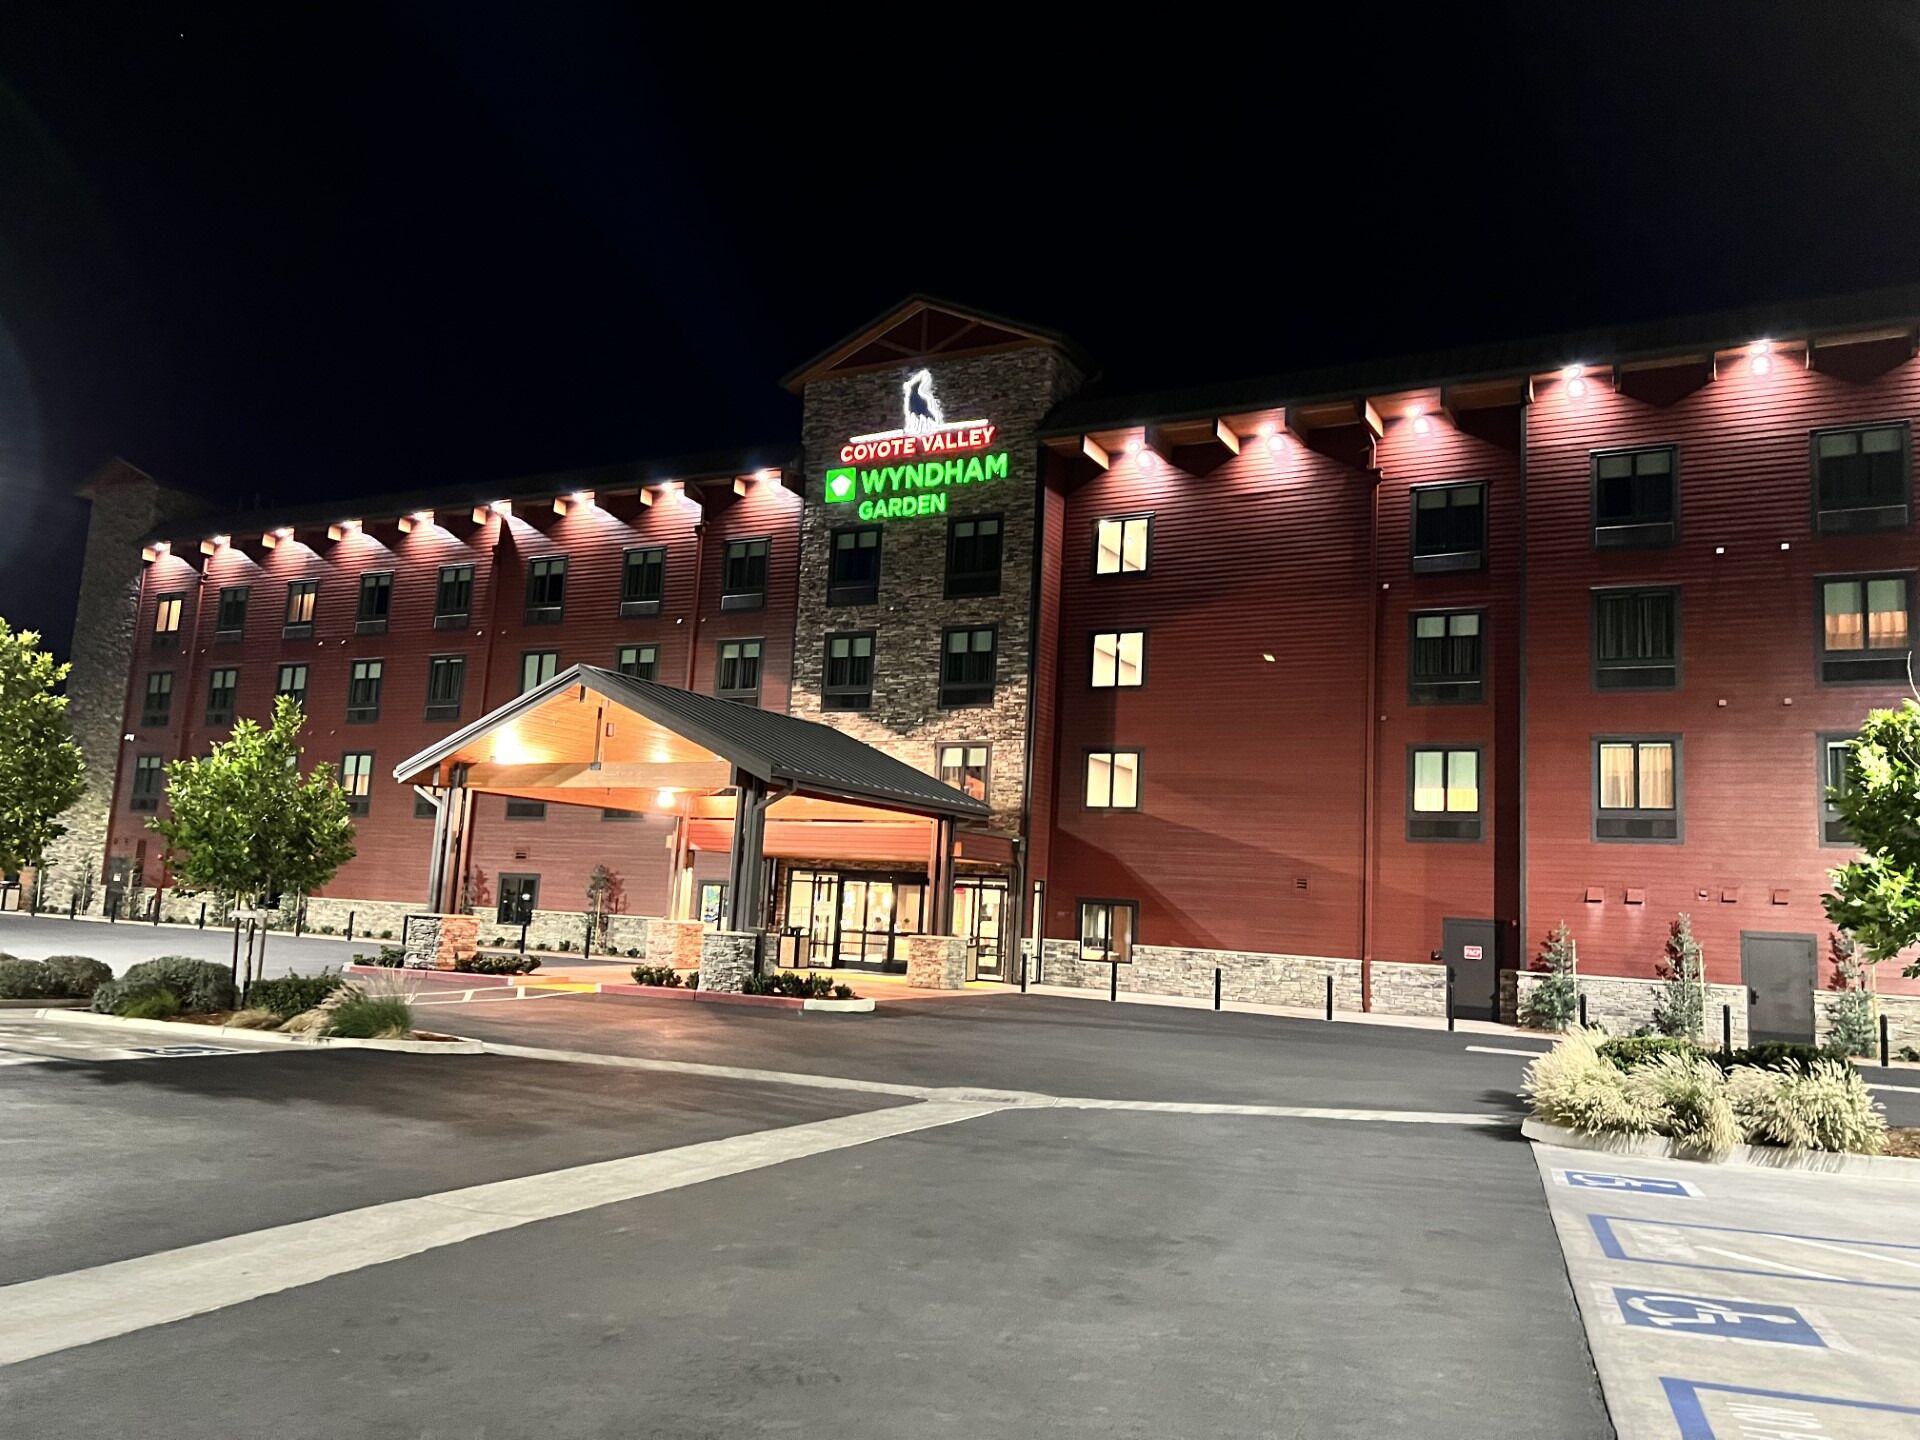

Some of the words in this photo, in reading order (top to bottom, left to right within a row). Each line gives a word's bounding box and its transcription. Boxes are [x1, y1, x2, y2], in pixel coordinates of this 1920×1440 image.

[840, 437, 916, 463] COYOTE
[921, 426, 996, 453] VALLEY
[860, 452, 1008, 494] WYNDHAM
[858, 492, 947, 521] GARDEN
